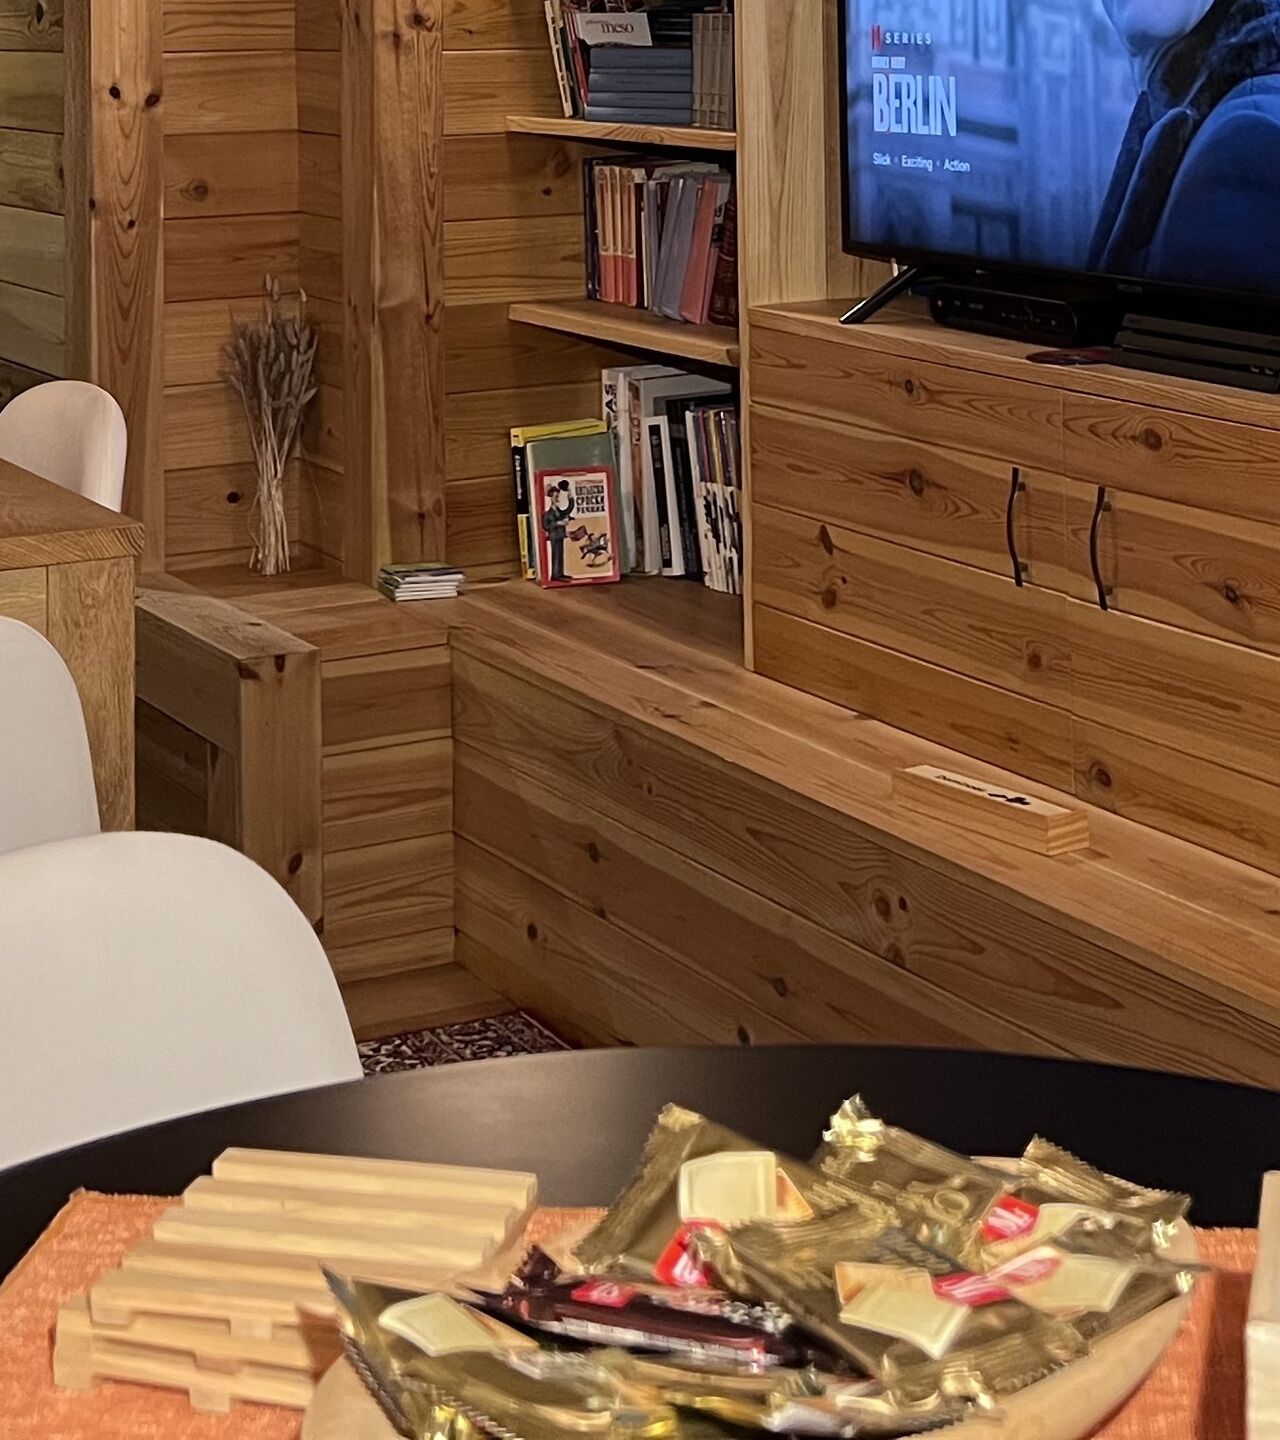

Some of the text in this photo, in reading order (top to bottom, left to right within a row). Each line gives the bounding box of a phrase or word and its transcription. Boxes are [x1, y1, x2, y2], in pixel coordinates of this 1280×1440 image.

[885, 32, 932, 45] SERIES
[872, 73, 958, 137] BERLIN
[872, 152, 971, 173] Slick Exciting Action
